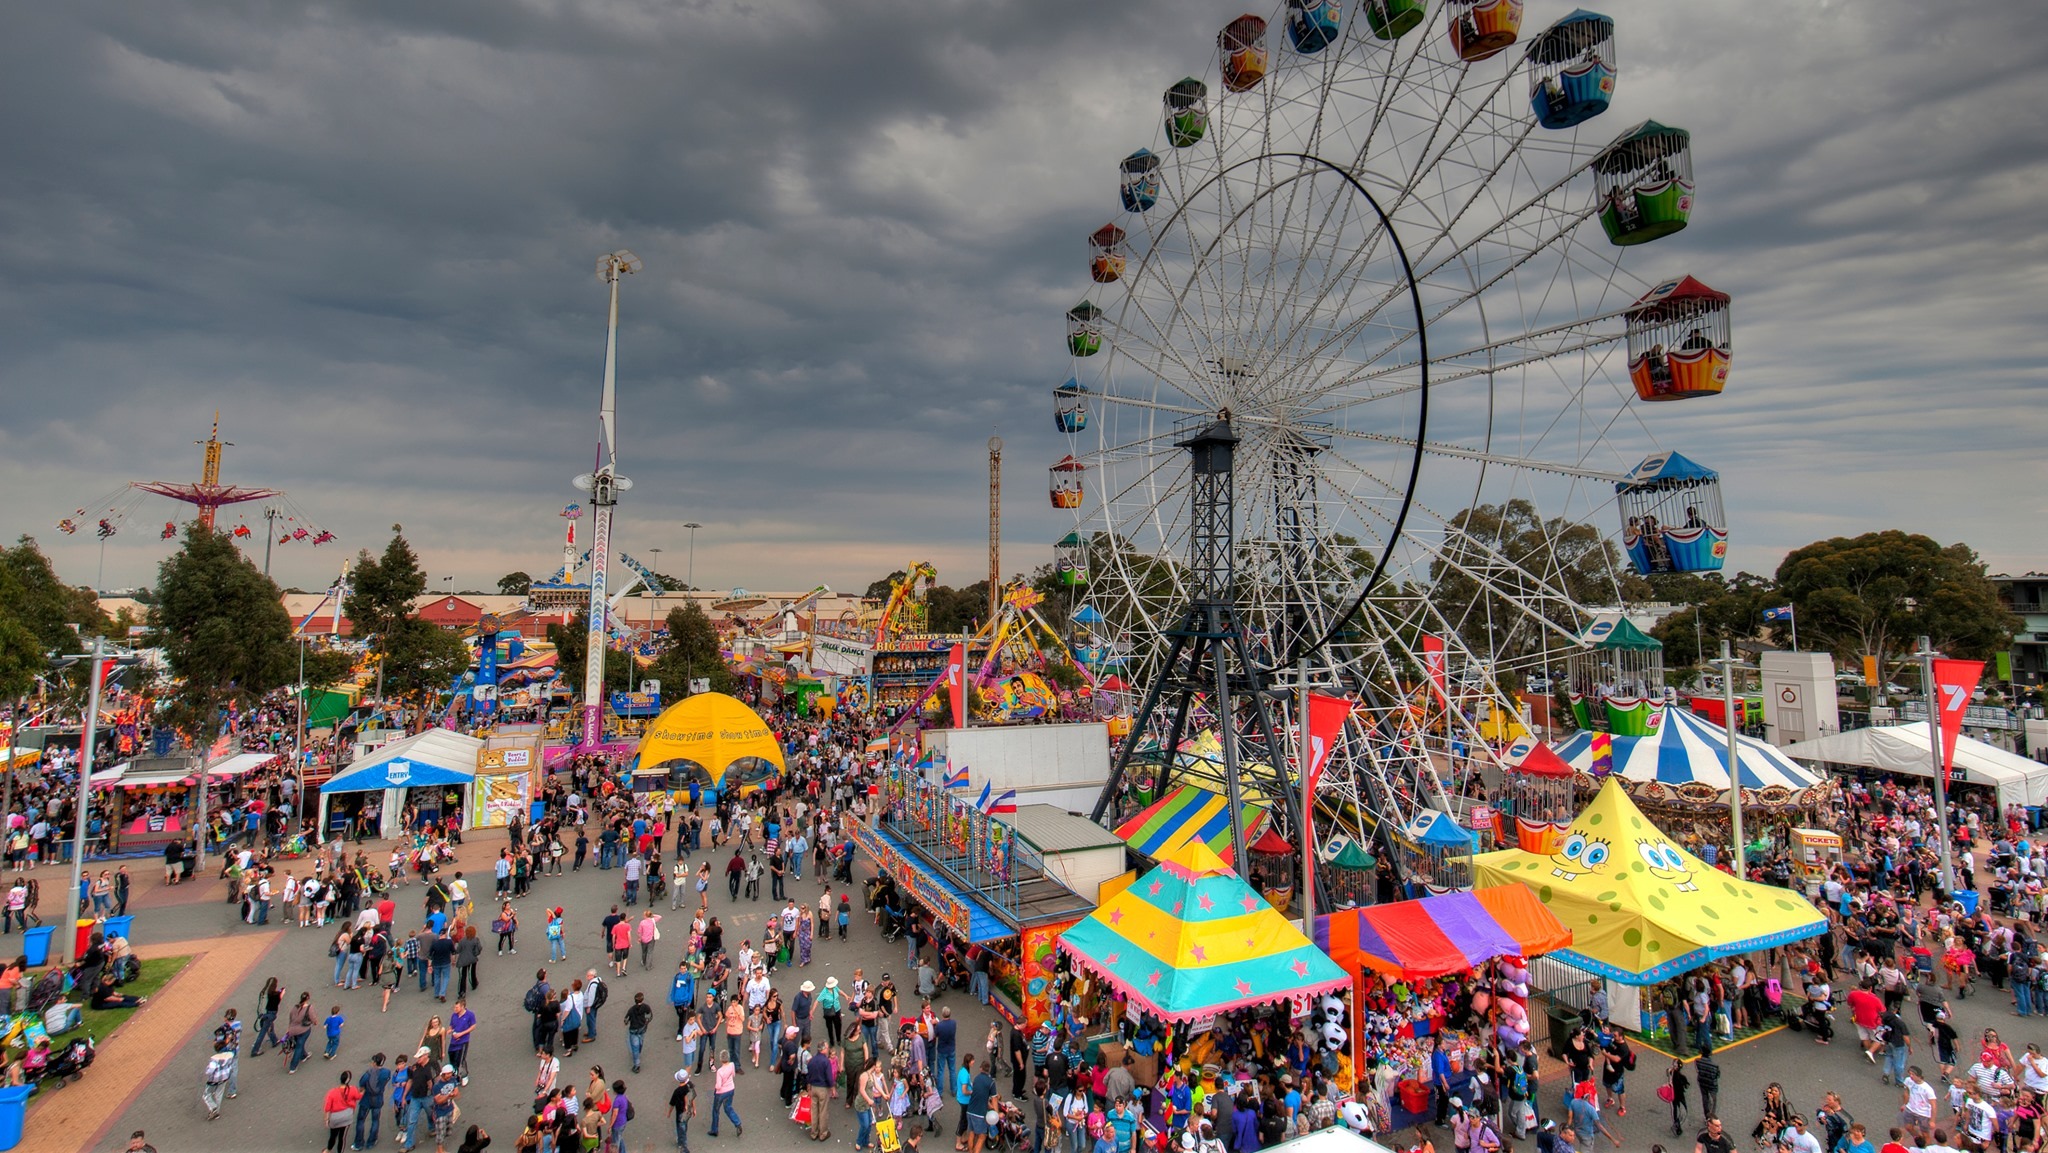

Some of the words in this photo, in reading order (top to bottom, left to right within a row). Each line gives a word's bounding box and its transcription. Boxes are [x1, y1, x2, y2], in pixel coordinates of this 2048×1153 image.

[1625, 223, 1637, 231] 22
[1003, 587, 1033, 603] HARD
[1015, 593, 1046, 608] ROCK
[841, 646, 865, 656] DANCE
[876, 642, 896, 651] BIG
[900, 641, 927, 651] GAME
[1940, 684, 1967, 711] 7
[586, 708, 596, 747] SPEED
[654, 729, 713, 741] showtime
[390, 771, 409, 779] ENTRY
[1293, 993, 1312, 1017] $1
